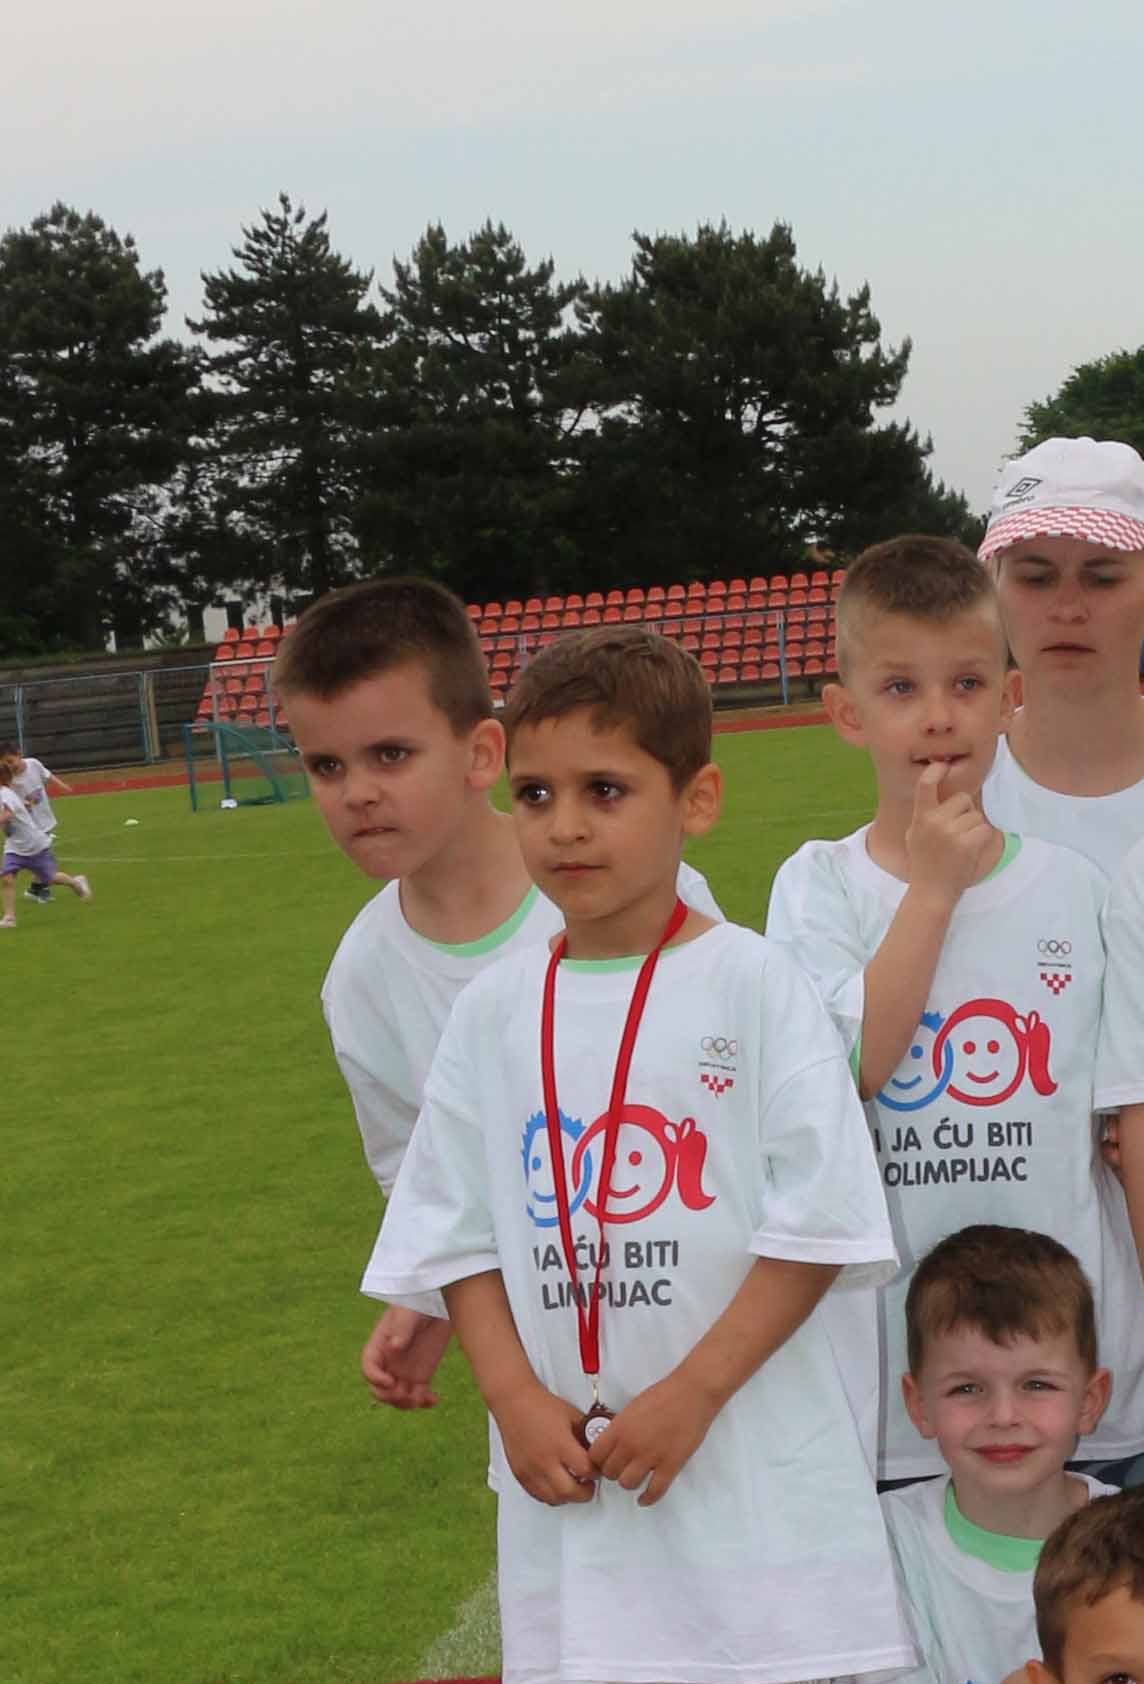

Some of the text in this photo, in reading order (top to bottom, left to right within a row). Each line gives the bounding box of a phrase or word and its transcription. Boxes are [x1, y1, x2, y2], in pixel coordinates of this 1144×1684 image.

[874, 1117, 1033, 1153] I JA ĆU BITI
[884, 1156, 1028, 1187] OLIMPIJAC
[574, 1234, 611, 1271] ĆU
[624, 1239, 679, 1269] BITI
[541, 1279, 673, 1310] LIMPIJAC
